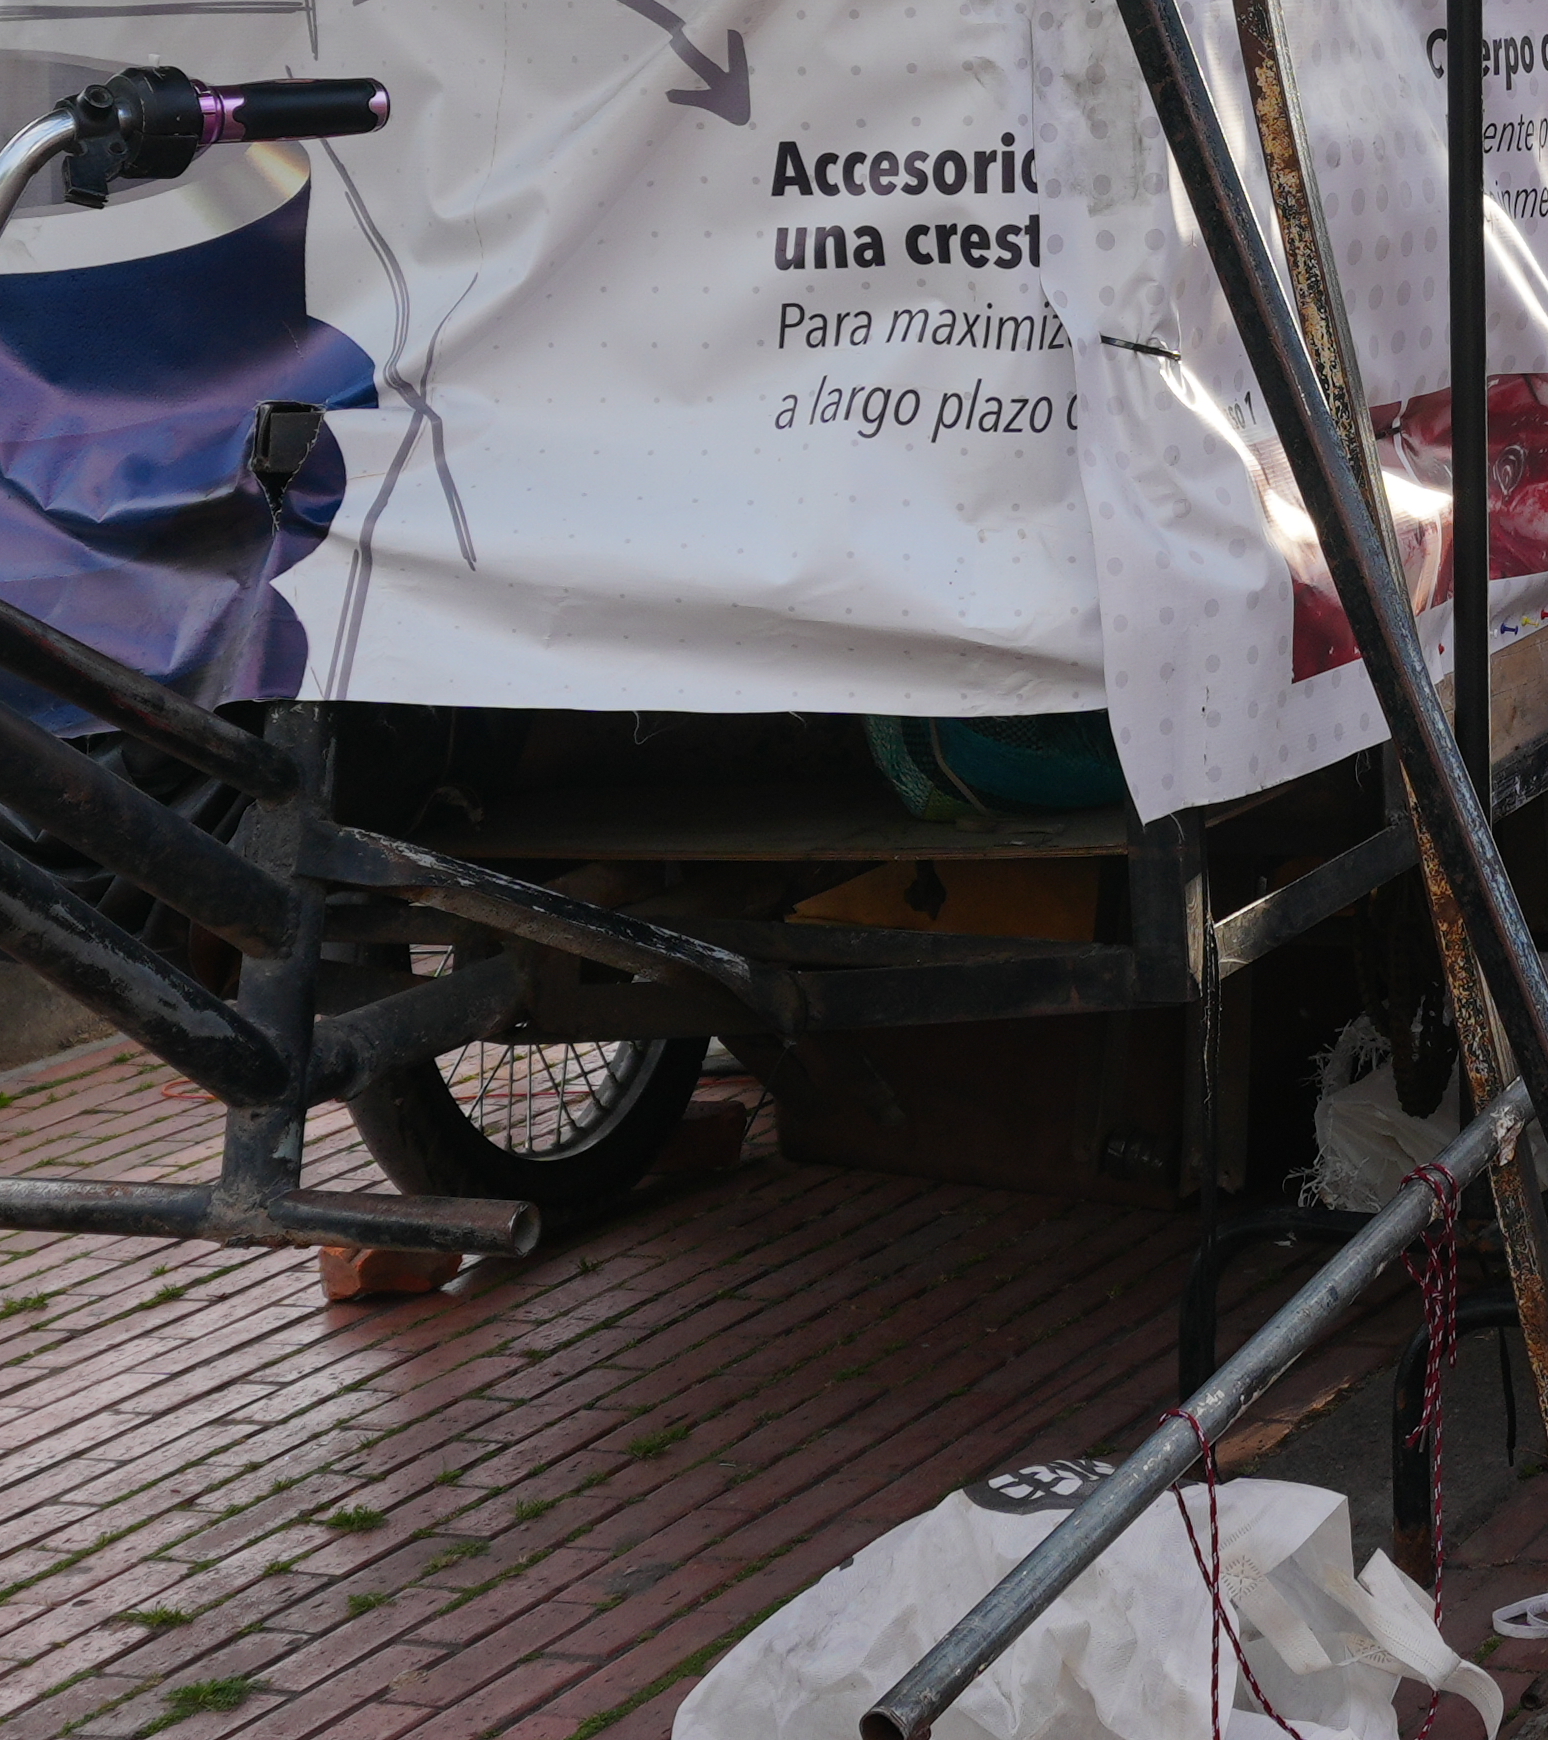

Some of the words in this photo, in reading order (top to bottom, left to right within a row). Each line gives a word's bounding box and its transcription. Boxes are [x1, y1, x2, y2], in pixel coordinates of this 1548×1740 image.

[1426, 27, 1535, 91] Cerpo
[773, 221, 886, 271] una
[777, 301, 873, 351] Para
[886, 299, 1073, 353] maximiz
[774, 392, 799, 432] a
[807, 374, 923, 440] largo
[929, 377, 1053, 444] plazo
